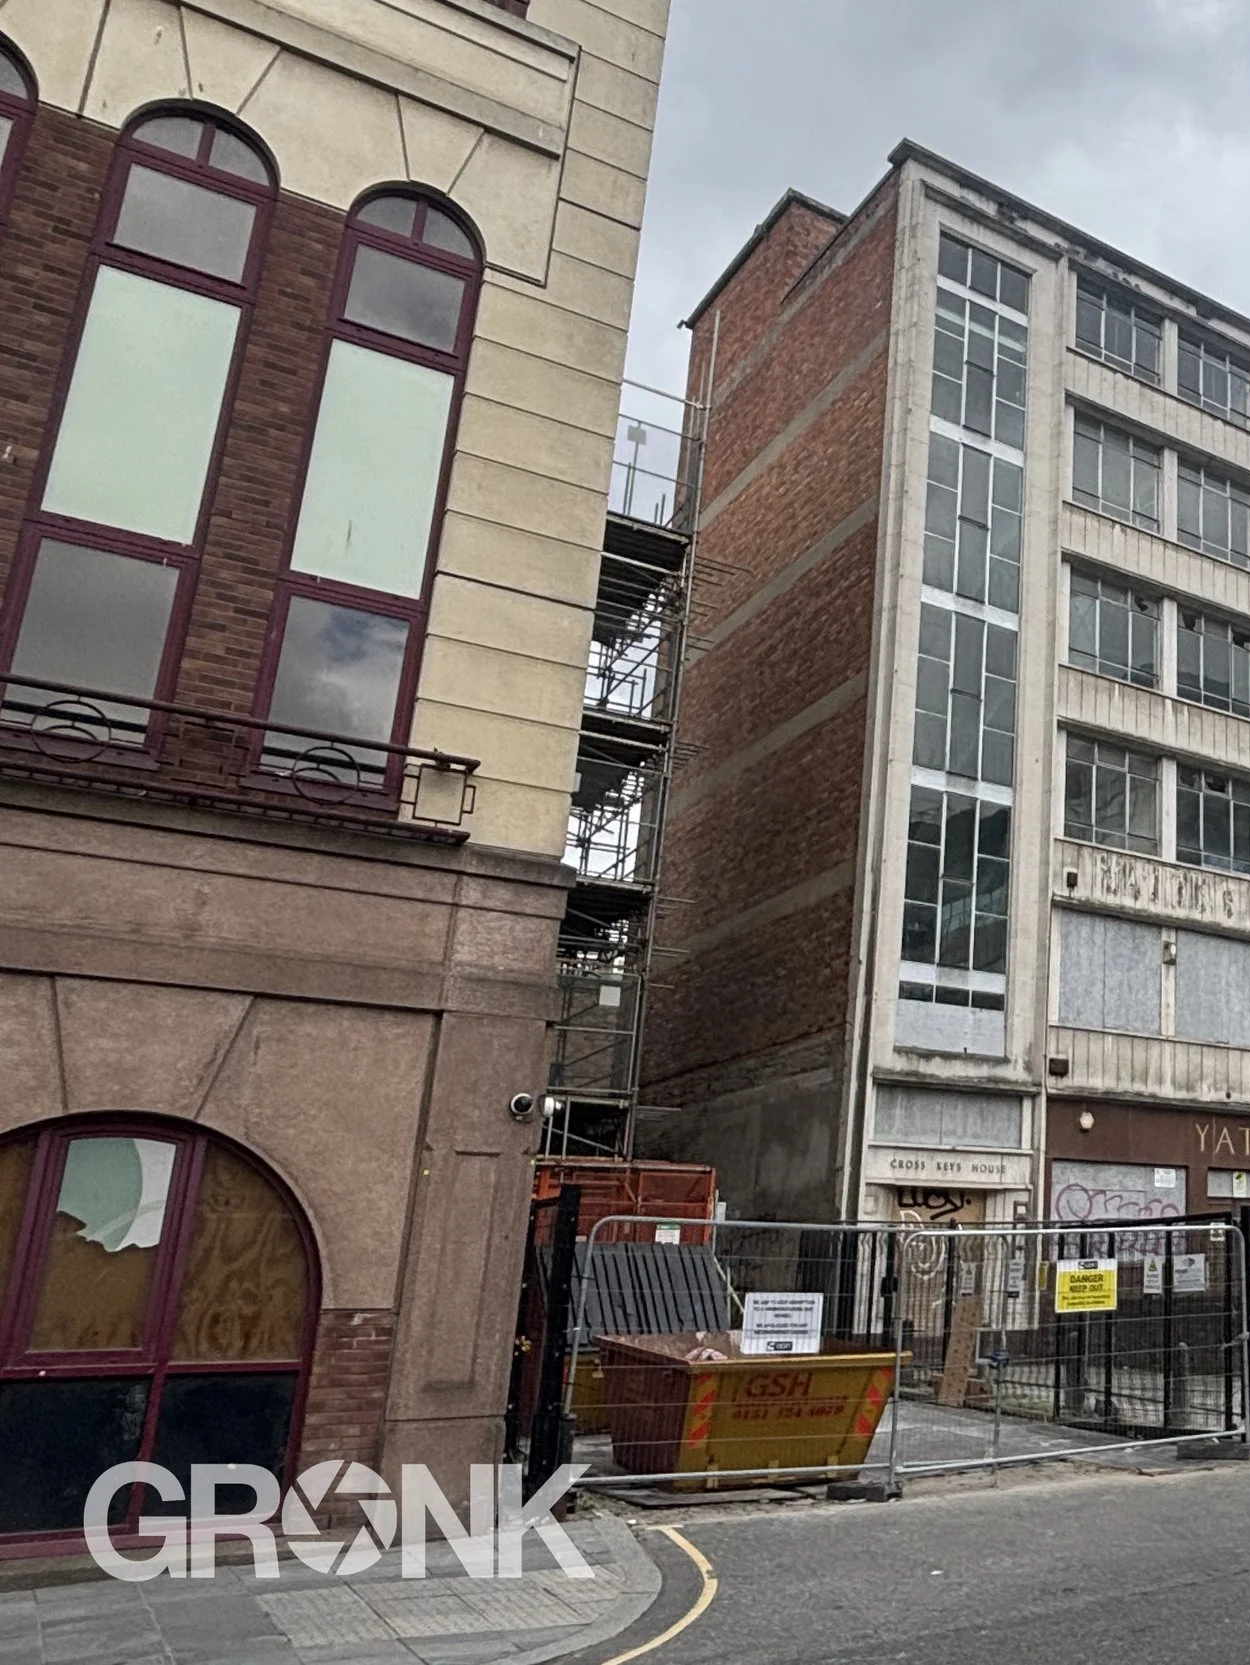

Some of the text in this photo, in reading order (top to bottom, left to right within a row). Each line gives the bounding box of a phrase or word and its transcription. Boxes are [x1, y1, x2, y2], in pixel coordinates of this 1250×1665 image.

[890, 1159, 1006, 1175] CROSS KEYS HOUSE
[1070, 1273, 1104, 1284] DANGER
[746, 1371, 813, 1398] GSH
